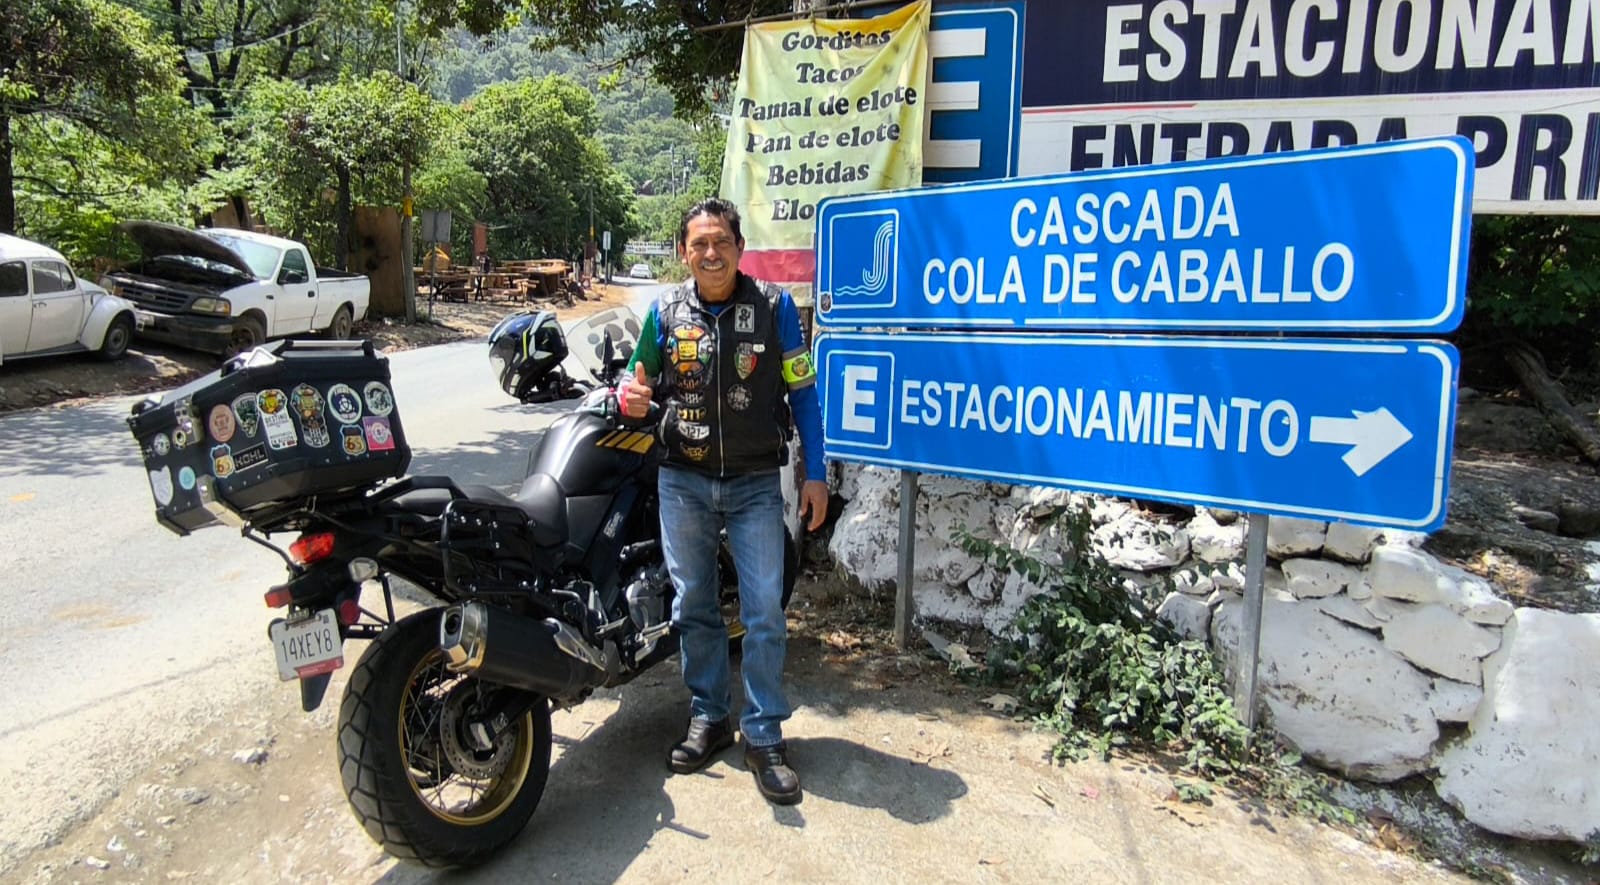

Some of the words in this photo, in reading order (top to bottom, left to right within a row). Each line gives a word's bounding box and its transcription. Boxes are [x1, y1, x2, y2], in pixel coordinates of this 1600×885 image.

[782, 29, 891, 51] Gorditas
[739, 98, 812, 120] Tamal
[818, 96, 849, 116] de
[857, 86, 917, 112] elote
[745, 132, 791, 153] Pan
[799, 131, 829, 149] de
[836, 123, 900, 147] elote
[766, 161, 870, 186] Bebidas
[1010, 183, 1240, 247] CASCADA
[922, 256, 1025, 305] COLA
[1043, 253, 1097, 303] DE
[1111, 242, 1354, 303] CABALLO
[842, 365, 877, 433] E
[901, 381, 1299, 456] ESTACIONAMIENTO
[281, 629, 332, 662] 14XEY8
